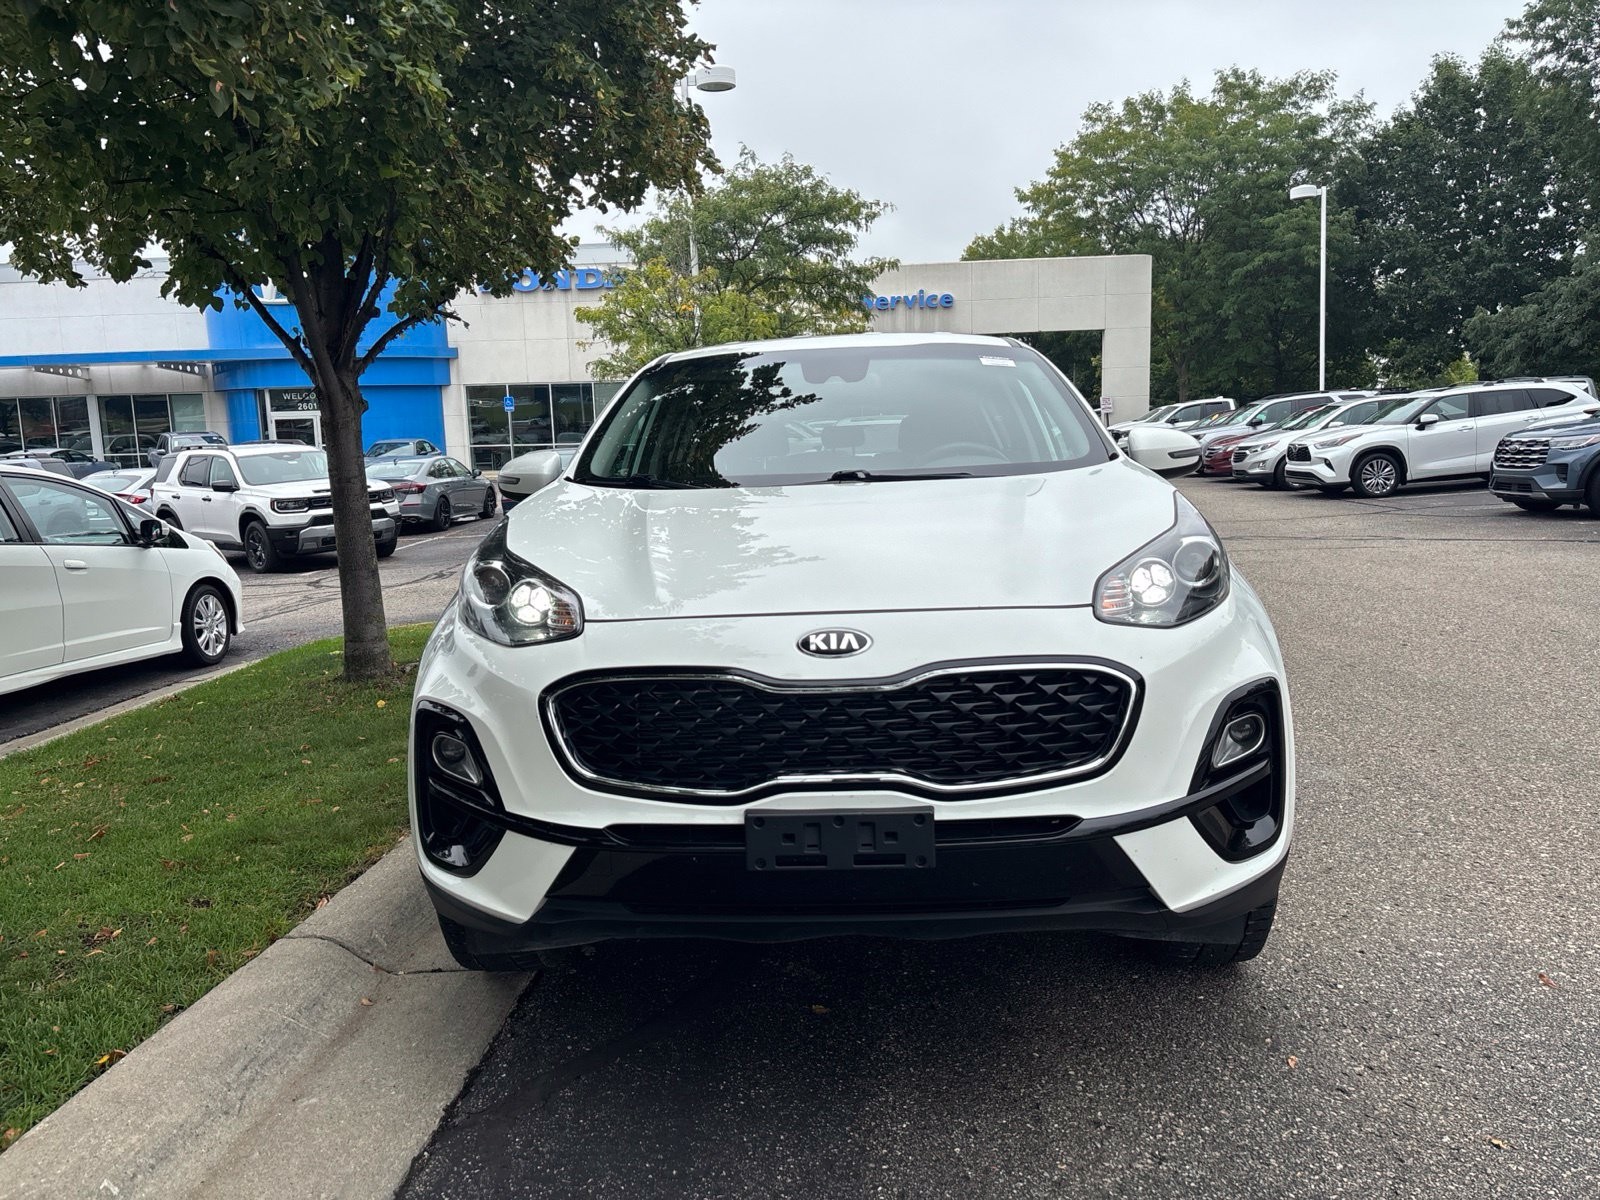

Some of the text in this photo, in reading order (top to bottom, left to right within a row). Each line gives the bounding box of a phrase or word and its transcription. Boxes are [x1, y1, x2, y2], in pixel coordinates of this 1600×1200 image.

[479, 266, 627, 292] OND
[282, 392, 317, 400] WELCO
[297, 402, 318, 411] 2601
[809, 632, 860, 651] KIA
